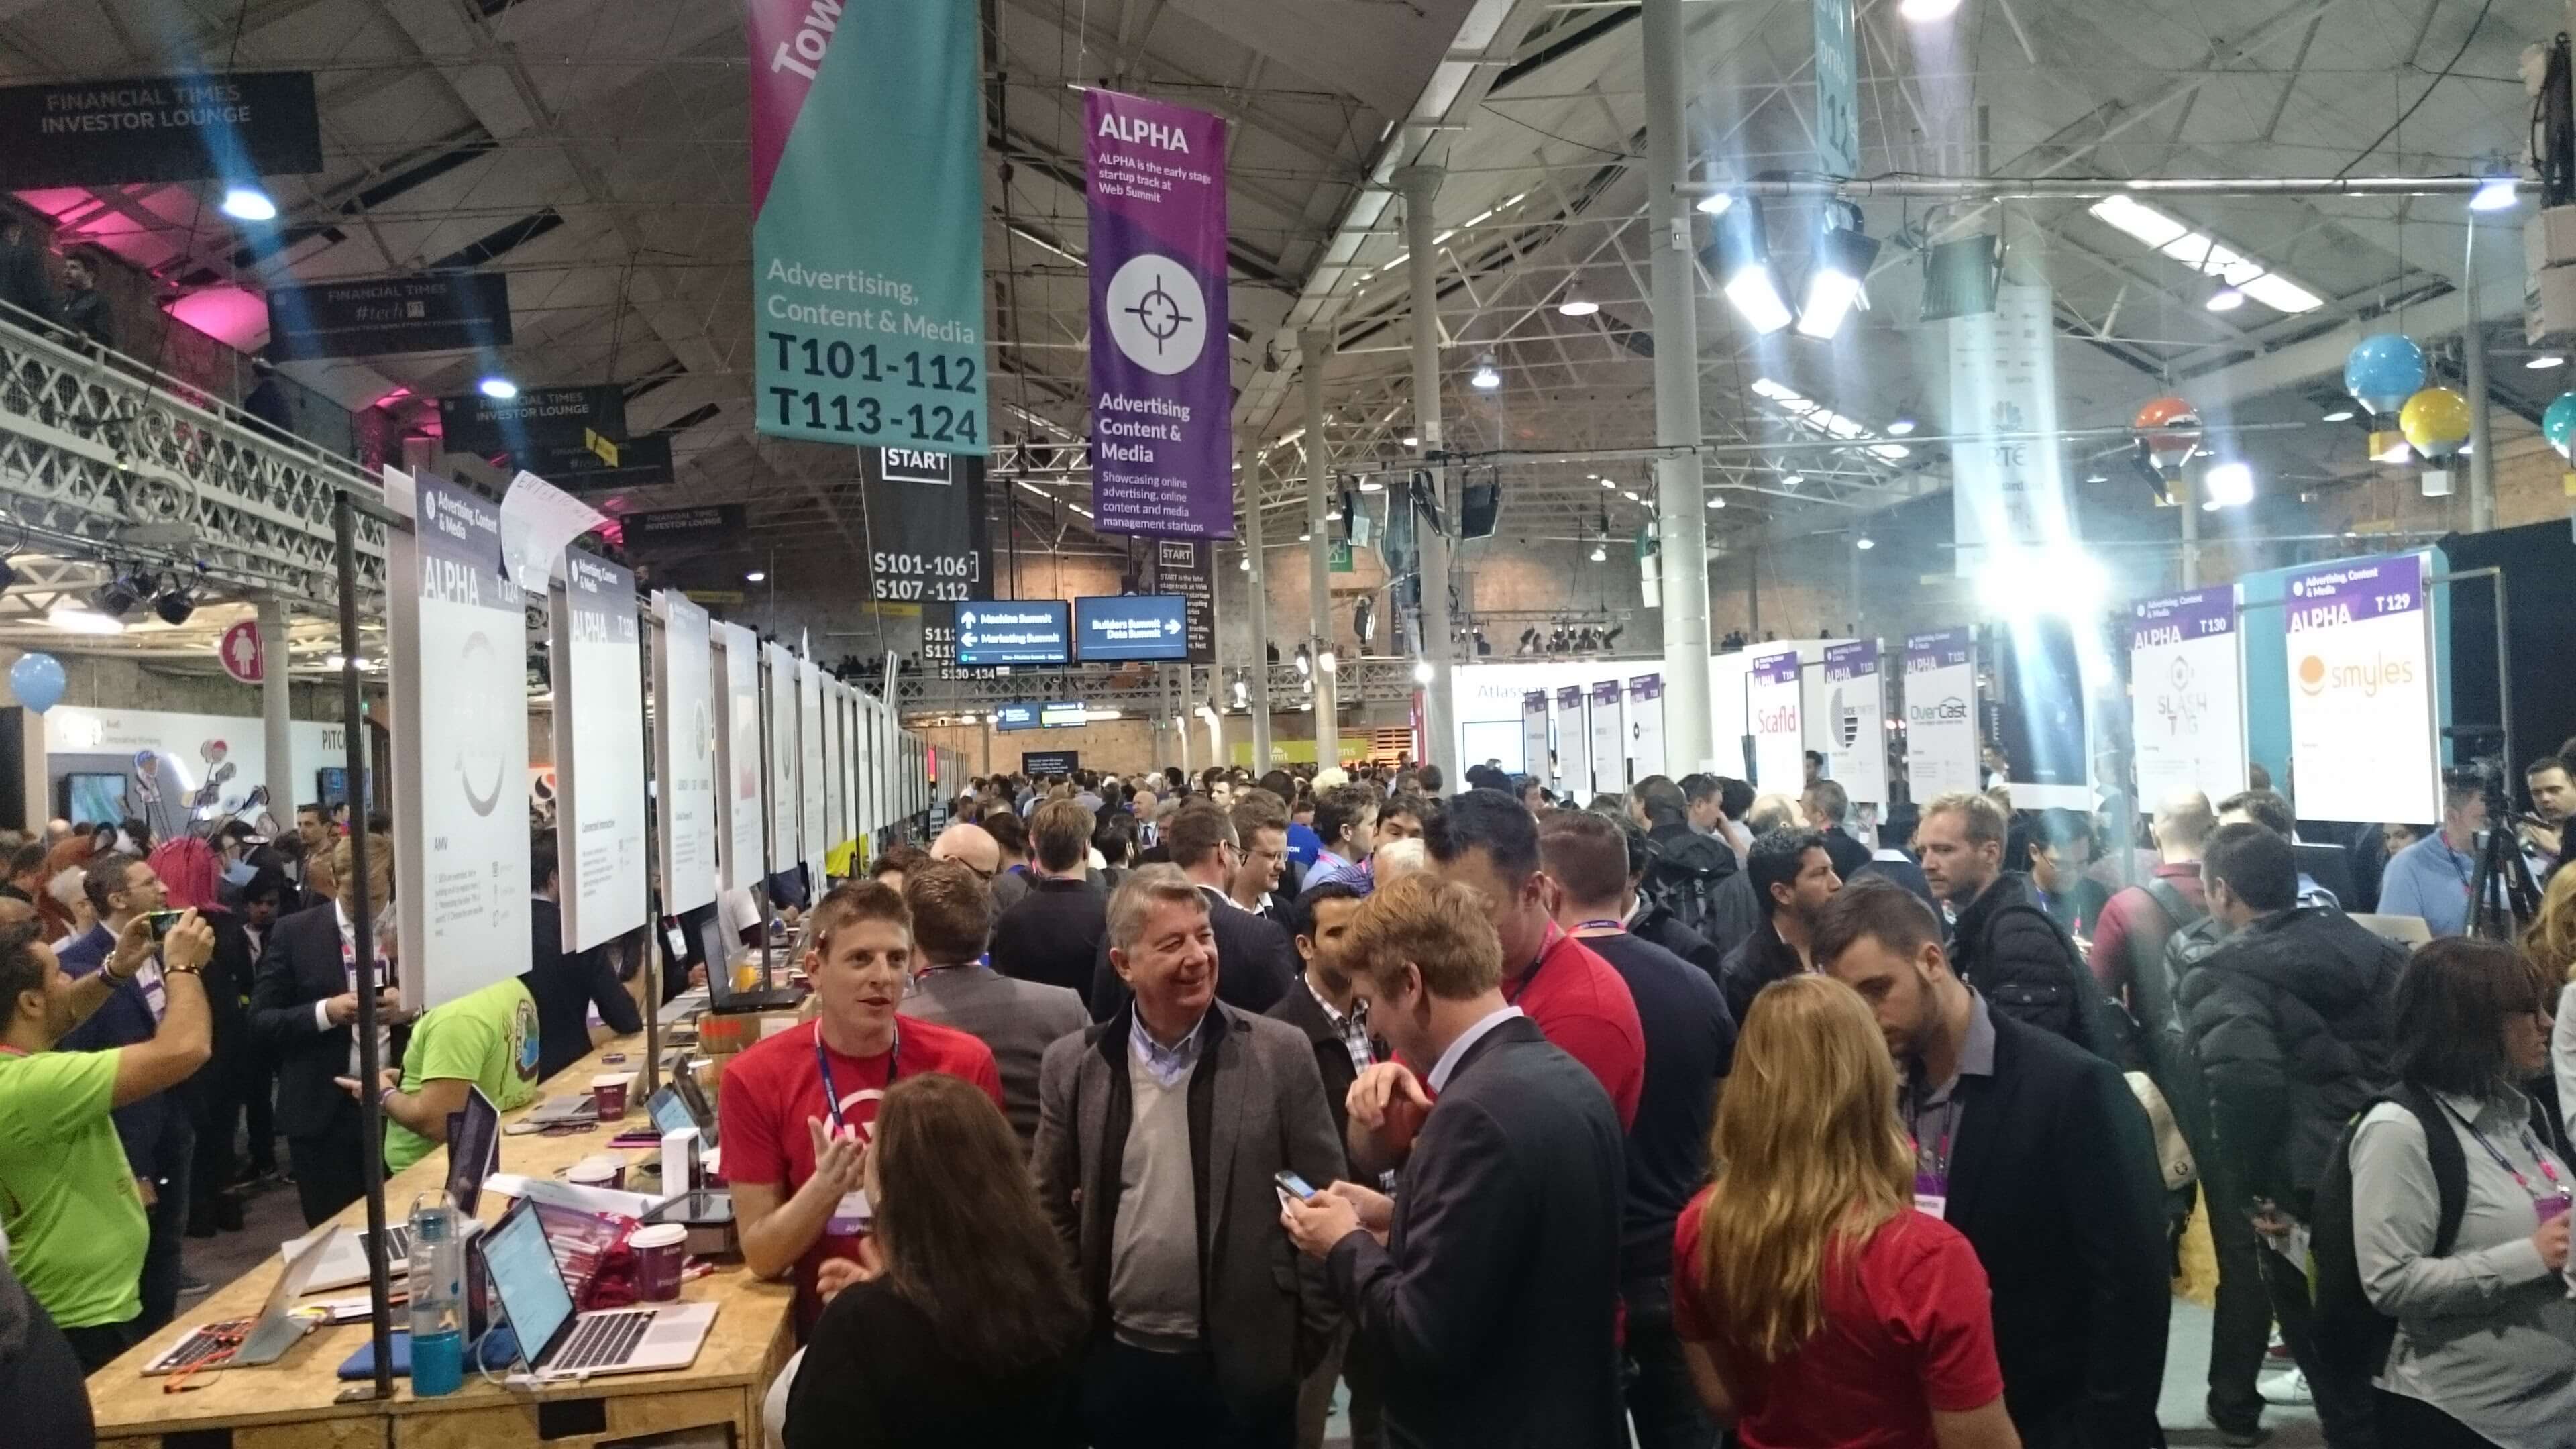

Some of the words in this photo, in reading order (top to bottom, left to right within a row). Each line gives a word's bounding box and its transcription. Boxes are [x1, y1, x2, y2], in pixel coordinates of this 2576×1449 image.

[46, 88, 166, 111] FINANCIAL
[174, 85, 240, 103] TIMES
[42, 111, 155, 134] INVESTOR
[161, 104, 252, 127] LOUNGE
[1098, 113, 1189, 154] ALPHA
[1099, 153, 1136, 169] ALPHA
[1137, 159, 1144, 170] is
[1146, 162, 1162, 174] the
[1163, 167, 1187, 180] early
[1099, 170, 1135, 184] startup
[1137, 175, 1160, 189] track
[1161, 180, 1172, 191] at
[1099, 182, 1123, 195] Web
[1126, 186, 1161, 203] Summit
[768, 258, 919, 305] Advertising,
[327, 287, 402, 302] FINANCIAL
[406, 284, 447, 296] TIMES
[768, 295, 873, 330] Content
[879, 309, 897, 333] &
[904, 313, 975, 344] Media
[769, 331, 977, 394] T101-112
[547, 392, 584, 402] TIMES
[1099, 392, 1191, 422] Advertising
[476, 407, 536, 421] INVESTOR
[540, 404, 589, 417] LOUNGE
[1099, 418, 1167, 440] Content
[1170, 425, 1181, 441] &
[888, 448, 947, 470] START
[1101, 443, 1154, 463] Media
[1102, 472, 1159, 488] Showcasing
[1161, 477, 1187, 488] online
[1102, 486, 1159, 502] advertising,
[1161, 491, 1187, 502] online
[646, 513, 690, 523] FINANCIAL
[694, 510, 719, 518] TIMES
[1102, 502, 1140, 514] content
[1142, 504, 1161, 515] and
[1163, 506, 1189, 517] media
[445, 519, 466, 539] Media
[476, 509, 498, 535] Content
[645, 521, 688, 531] INVESTOR
[688, 517, 722, 527] LOUNGE
[1103, 517, 1165, 531] management
[1167, 521, 1204, 533] startups
[875, 552, 967, 576] S101-106
[1163, 549, 1191, 560] START
[423, 556, 480, 606] ALPHA
[2349, 567, 2378, 581] Content
[2313, 586, 2337, 597] Media
[573, 609, 608, 642] ALPHA
[981, 613, 1018, 624] Machine
[1018, 612, 1053, 623] Summit
[1092, 619, 1128, 629] Builders
[1128, 618, 1161, 629] Summit
[2290, 604, 2352, 633] ALPHA
[981, 633, 1026, 644] Marketing
[1026, 632, 1060, 643] Summit
[1106, 629, 1128, 639] Data
[1128, 628, 1161, 639] Summit
[2133, 625, 2182, 650] ALPHA
[1907, 656, 1937, 674] ALPHA
[2332, 649, 2413, 698] smyles
[1826, 667, 1851, 684] ALPHA
[1910, 703, 1967, 720] OverCast
